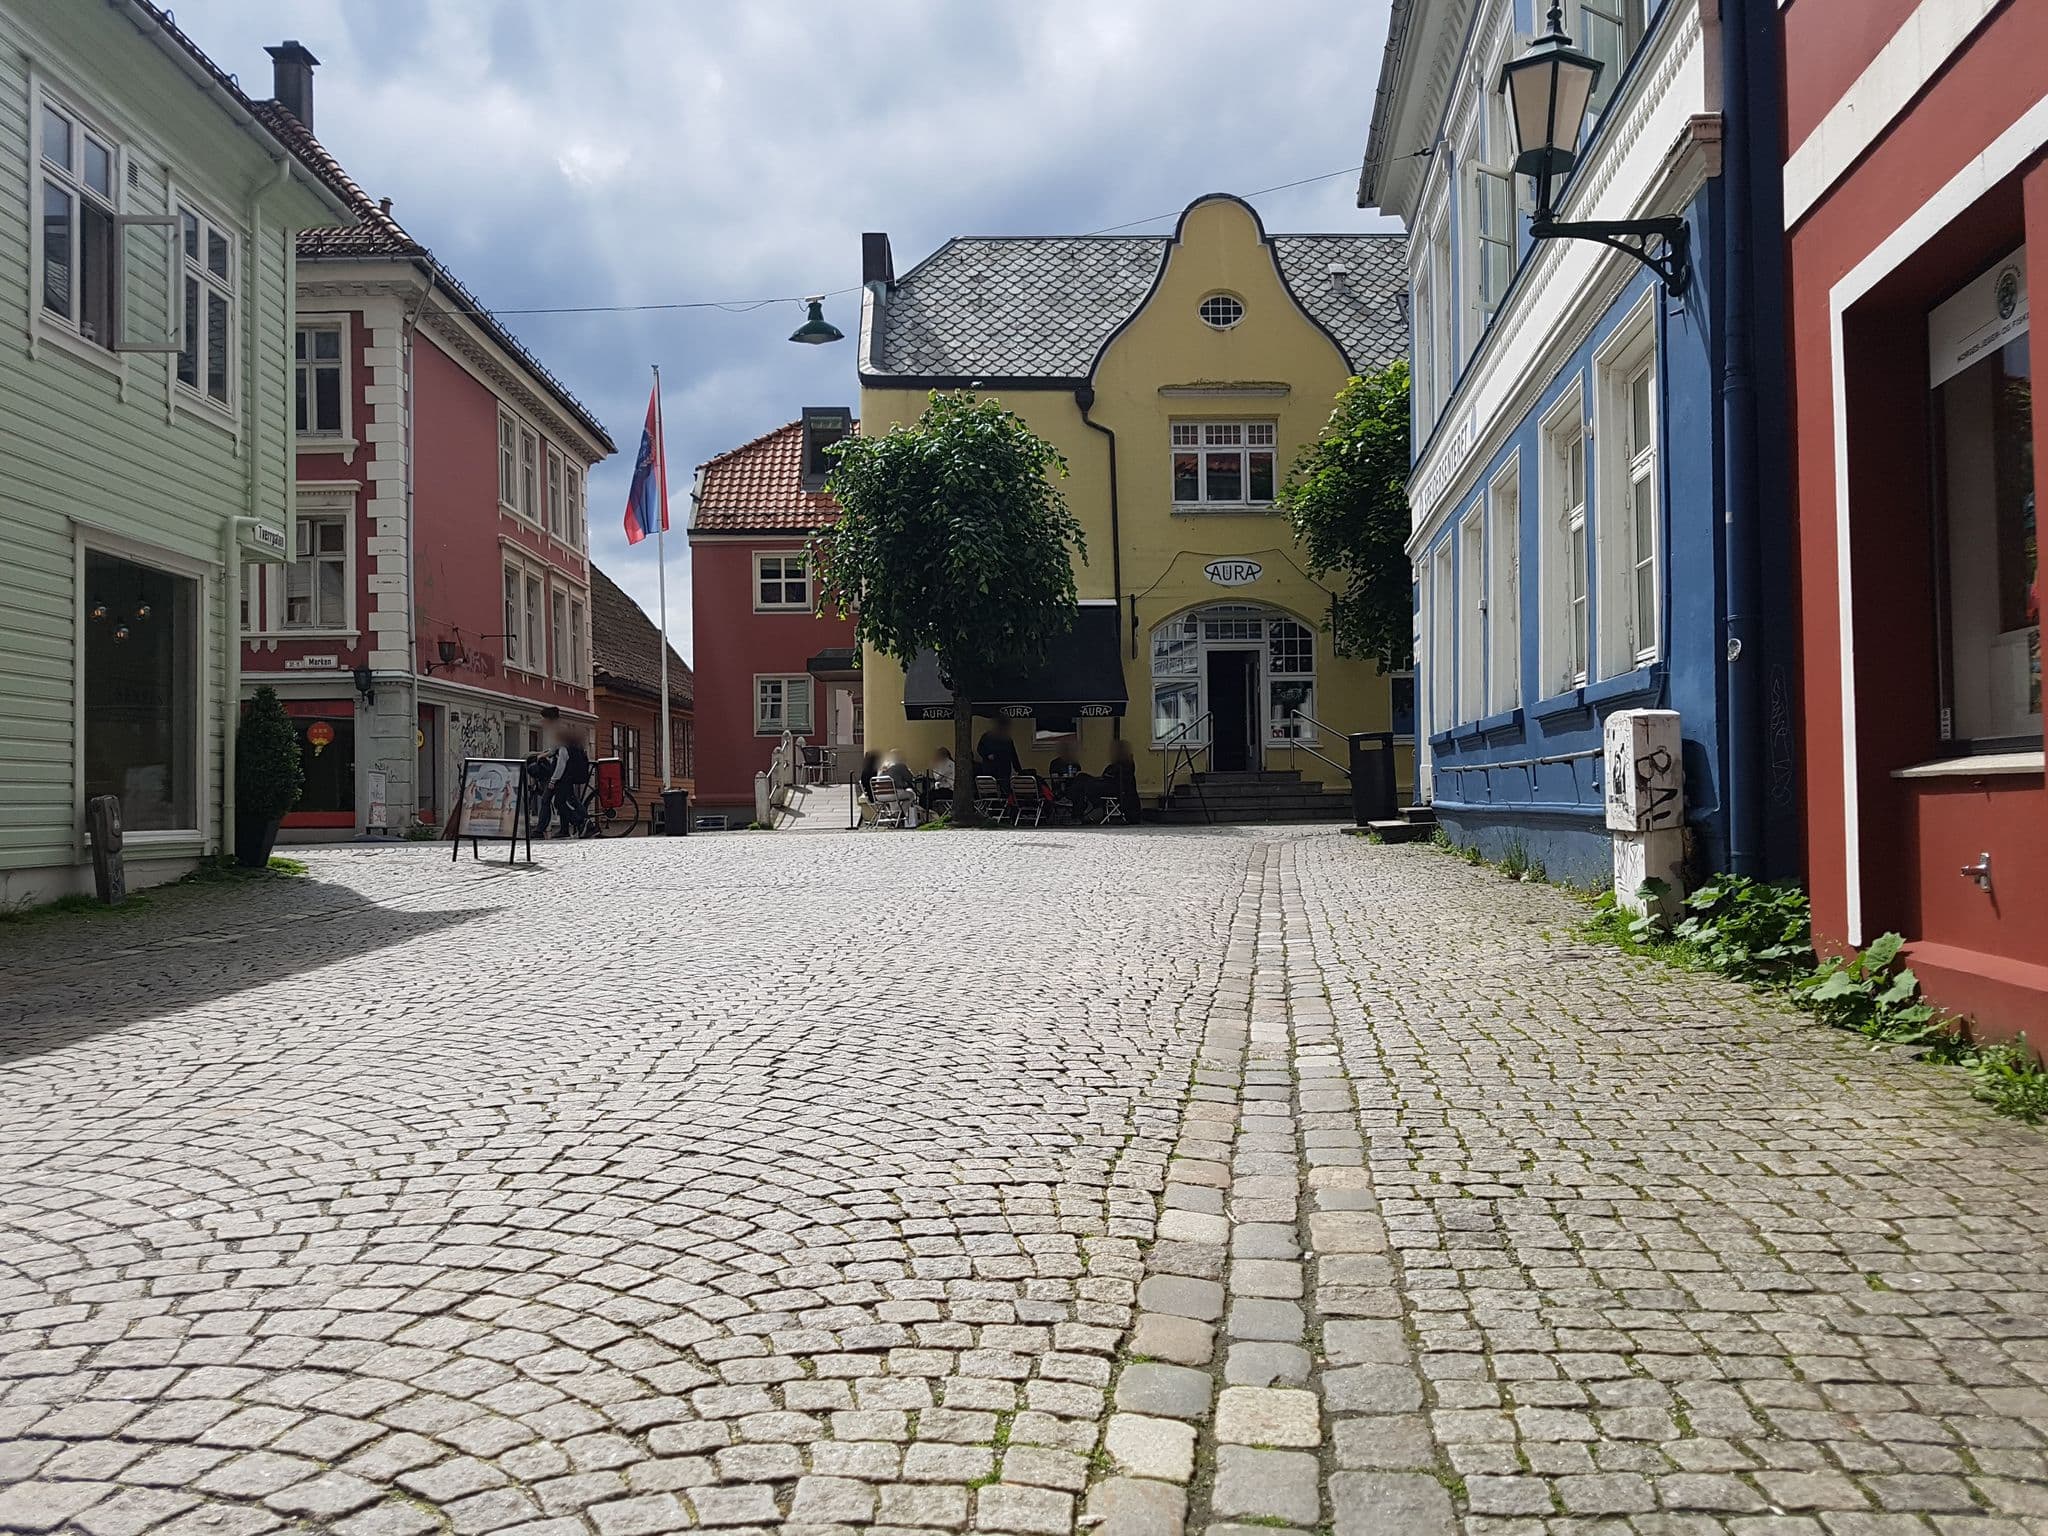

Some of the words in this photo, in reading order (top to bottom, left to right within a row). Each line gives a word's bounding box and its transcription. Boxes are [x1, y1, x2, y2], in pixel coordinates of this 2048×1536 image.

[1209, 564, 1257, 581] AURA
[922, 708, 952, 719] AURA
[1002, 706, 1031, 717] AURA
[1081, 705, 1111, 716] AURA
